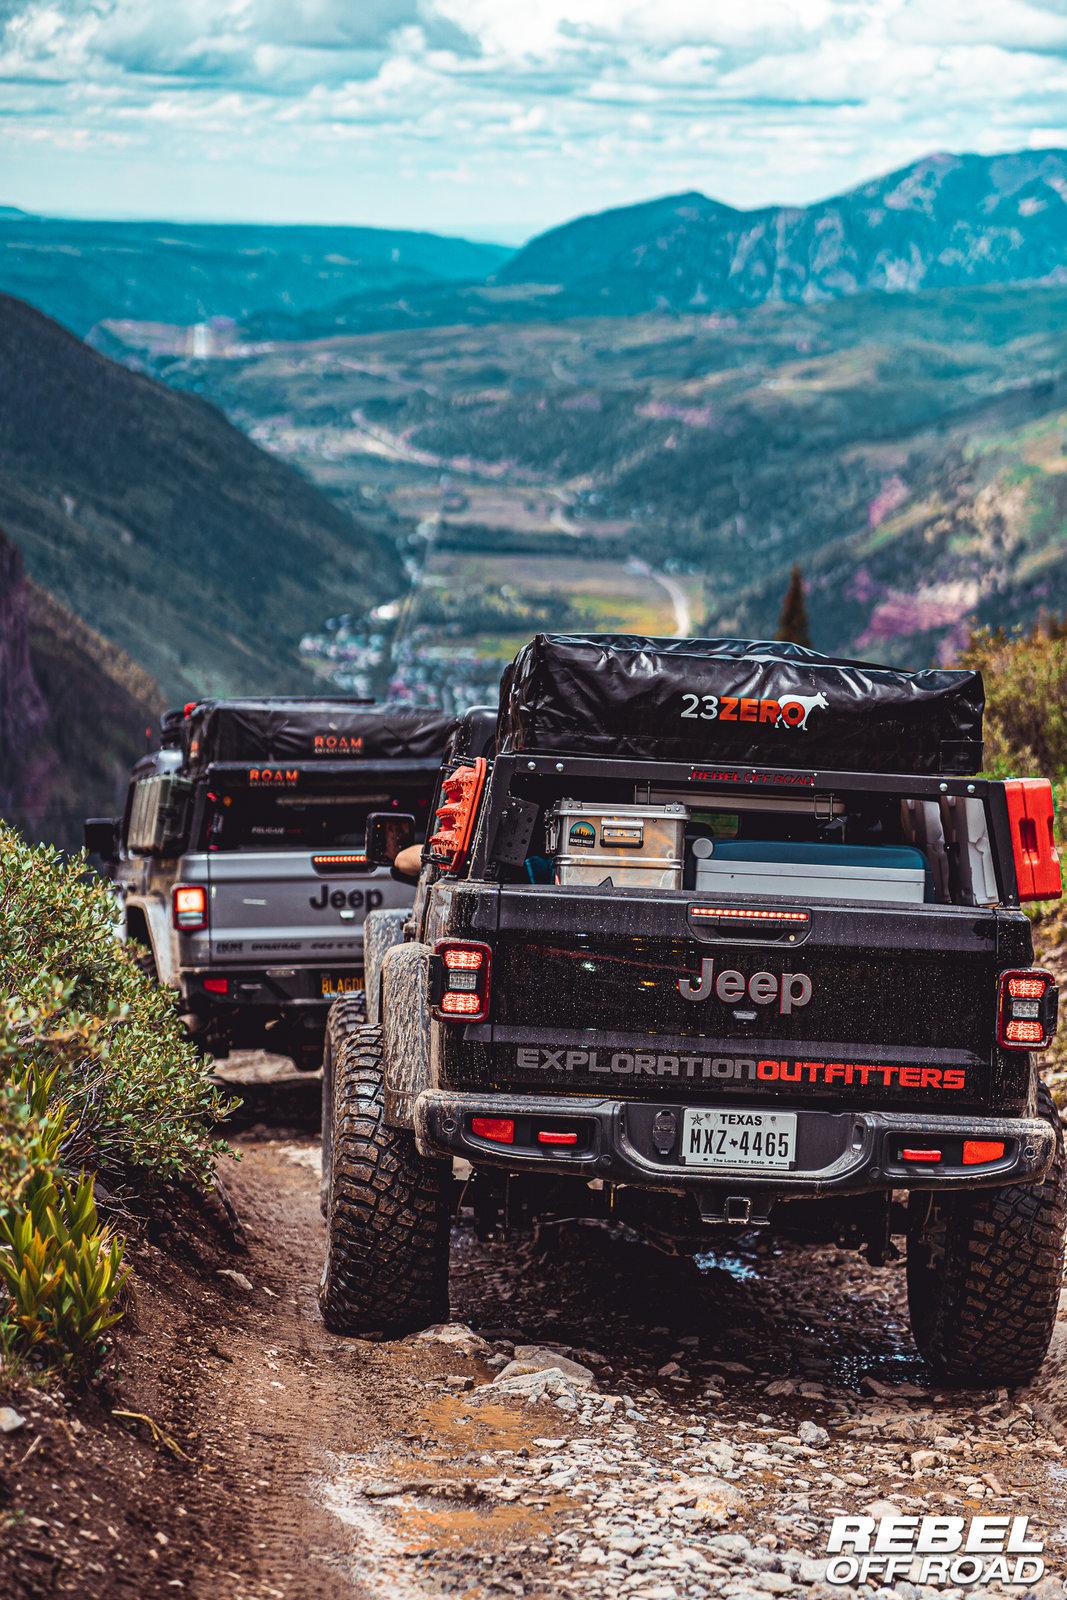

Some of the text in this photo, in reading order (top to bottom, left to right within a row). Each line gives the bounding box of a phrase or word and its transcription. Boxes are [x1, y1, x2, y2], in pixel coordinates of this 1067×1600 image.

[681, 694, 805, 726] 23ZERO
[314, 736, 364, 748] ROAM
[249, 769, 299, 782] ROAM
[691, 769, 741, 783] REBEL
[309, 884, 383, 912] Jeep
[678, 957, 812, 1014] Jeep
[720, 1113, 763, 1126] TEXAS
[689, 1128, 789, 1158] MXZ 4465
